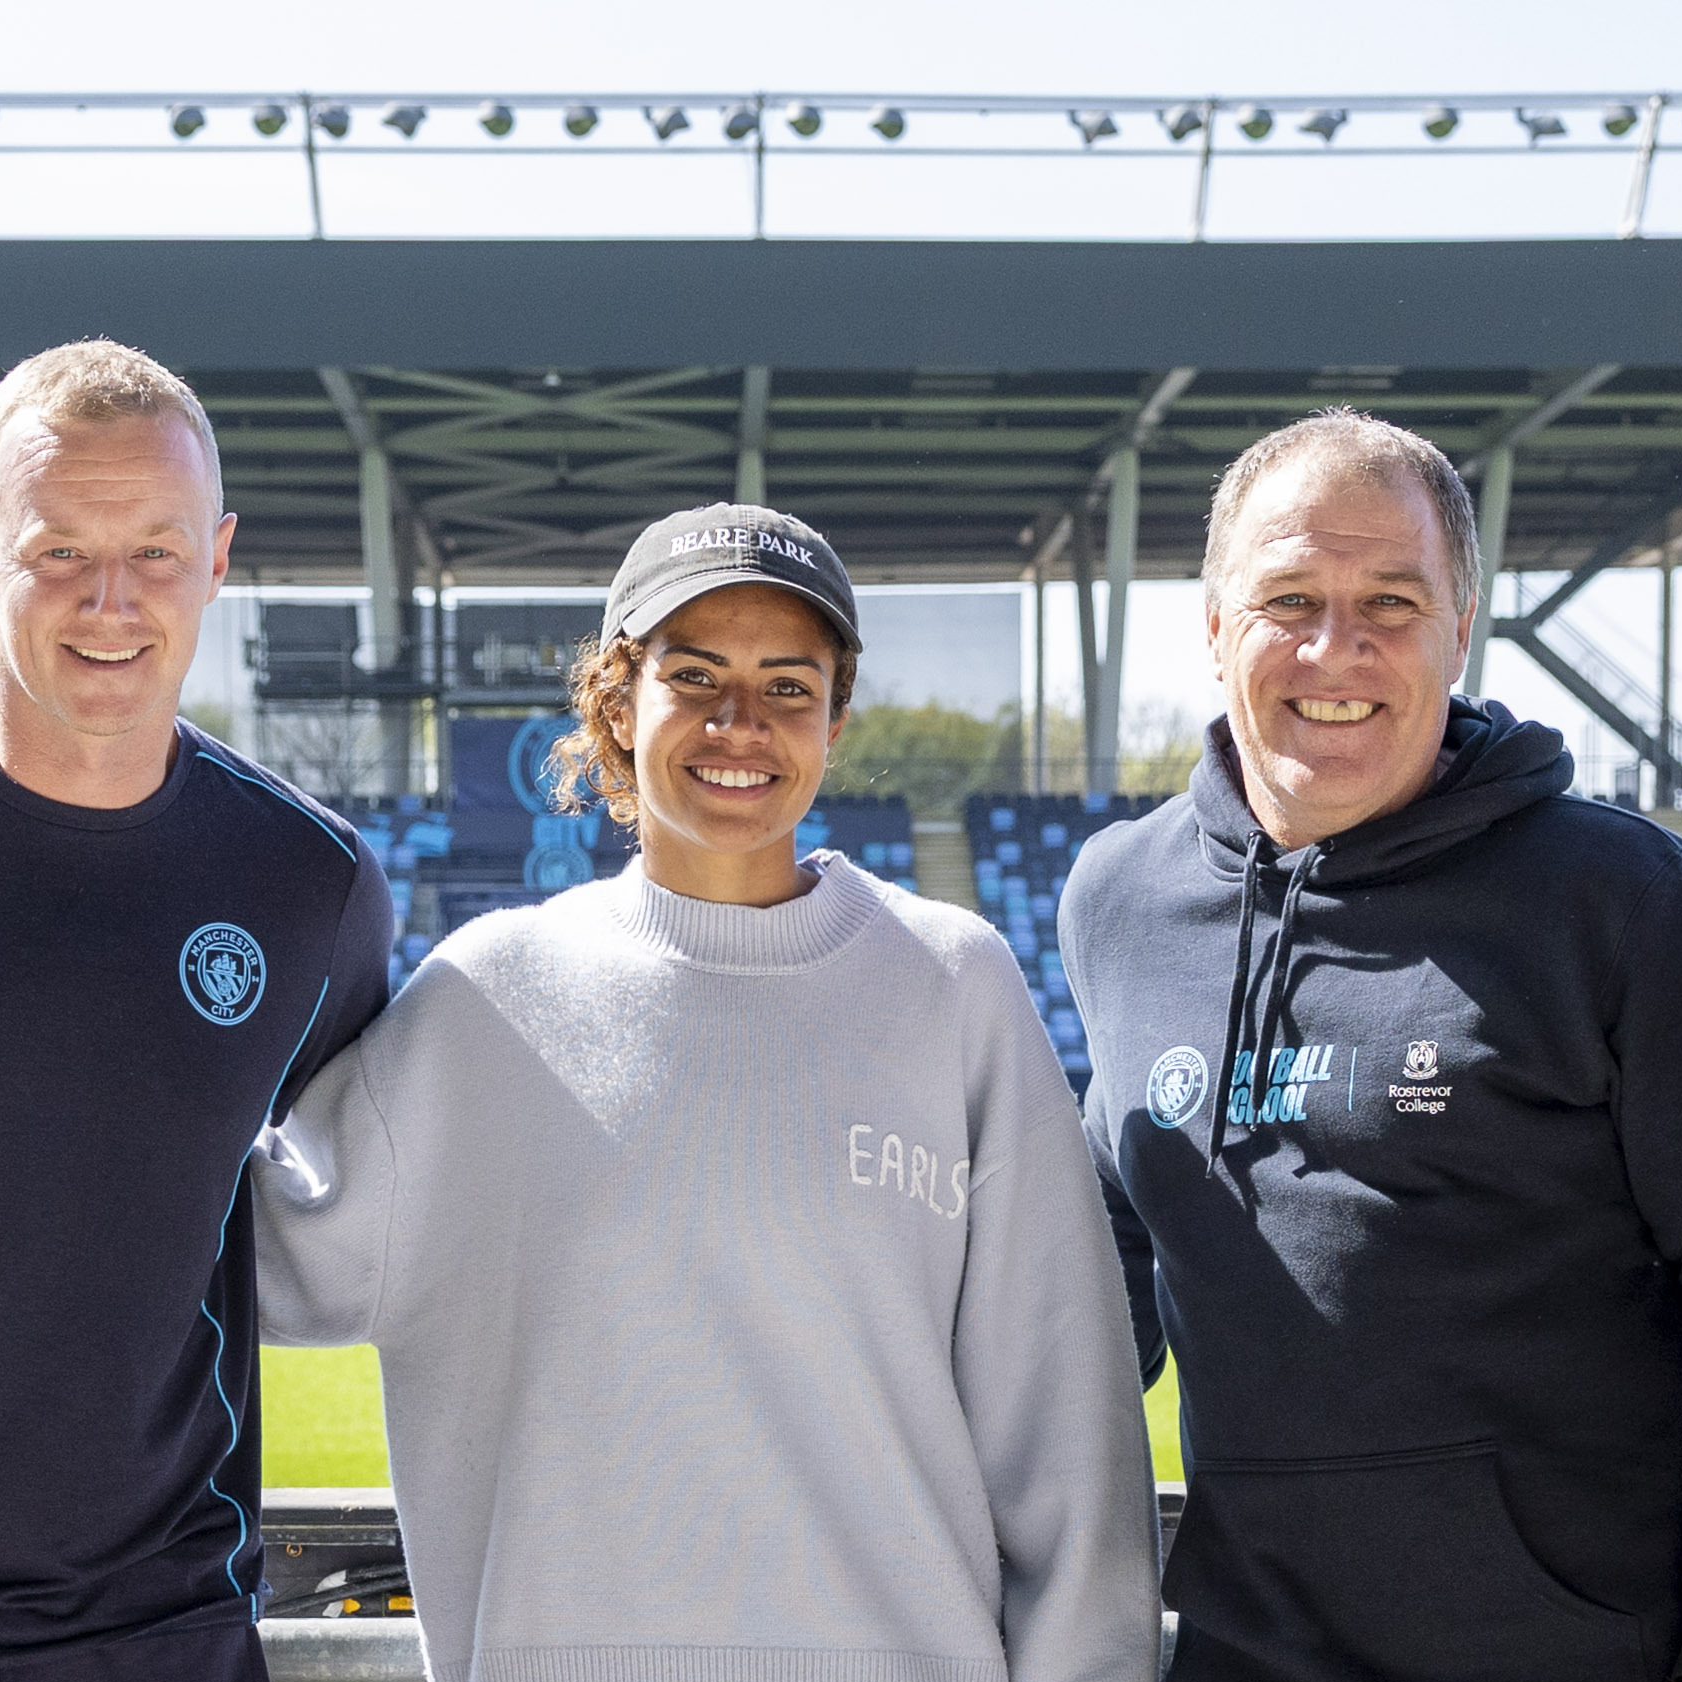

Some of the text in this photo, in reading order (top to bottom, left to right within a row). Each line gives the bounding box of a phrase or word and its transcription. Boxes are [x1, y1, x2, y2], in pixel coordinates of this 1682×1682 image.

[669, 528, 819, 570] BEARE PARK
[190, 931, 258, 967] MANCHESTER
[211, 1005, 235, 1017] CITY
[1388, 1084, 1453, 1098] Rostrevor
[1396, 1098, 1446, 1115] College
[849, 1124, 970, 1220] EARLS
